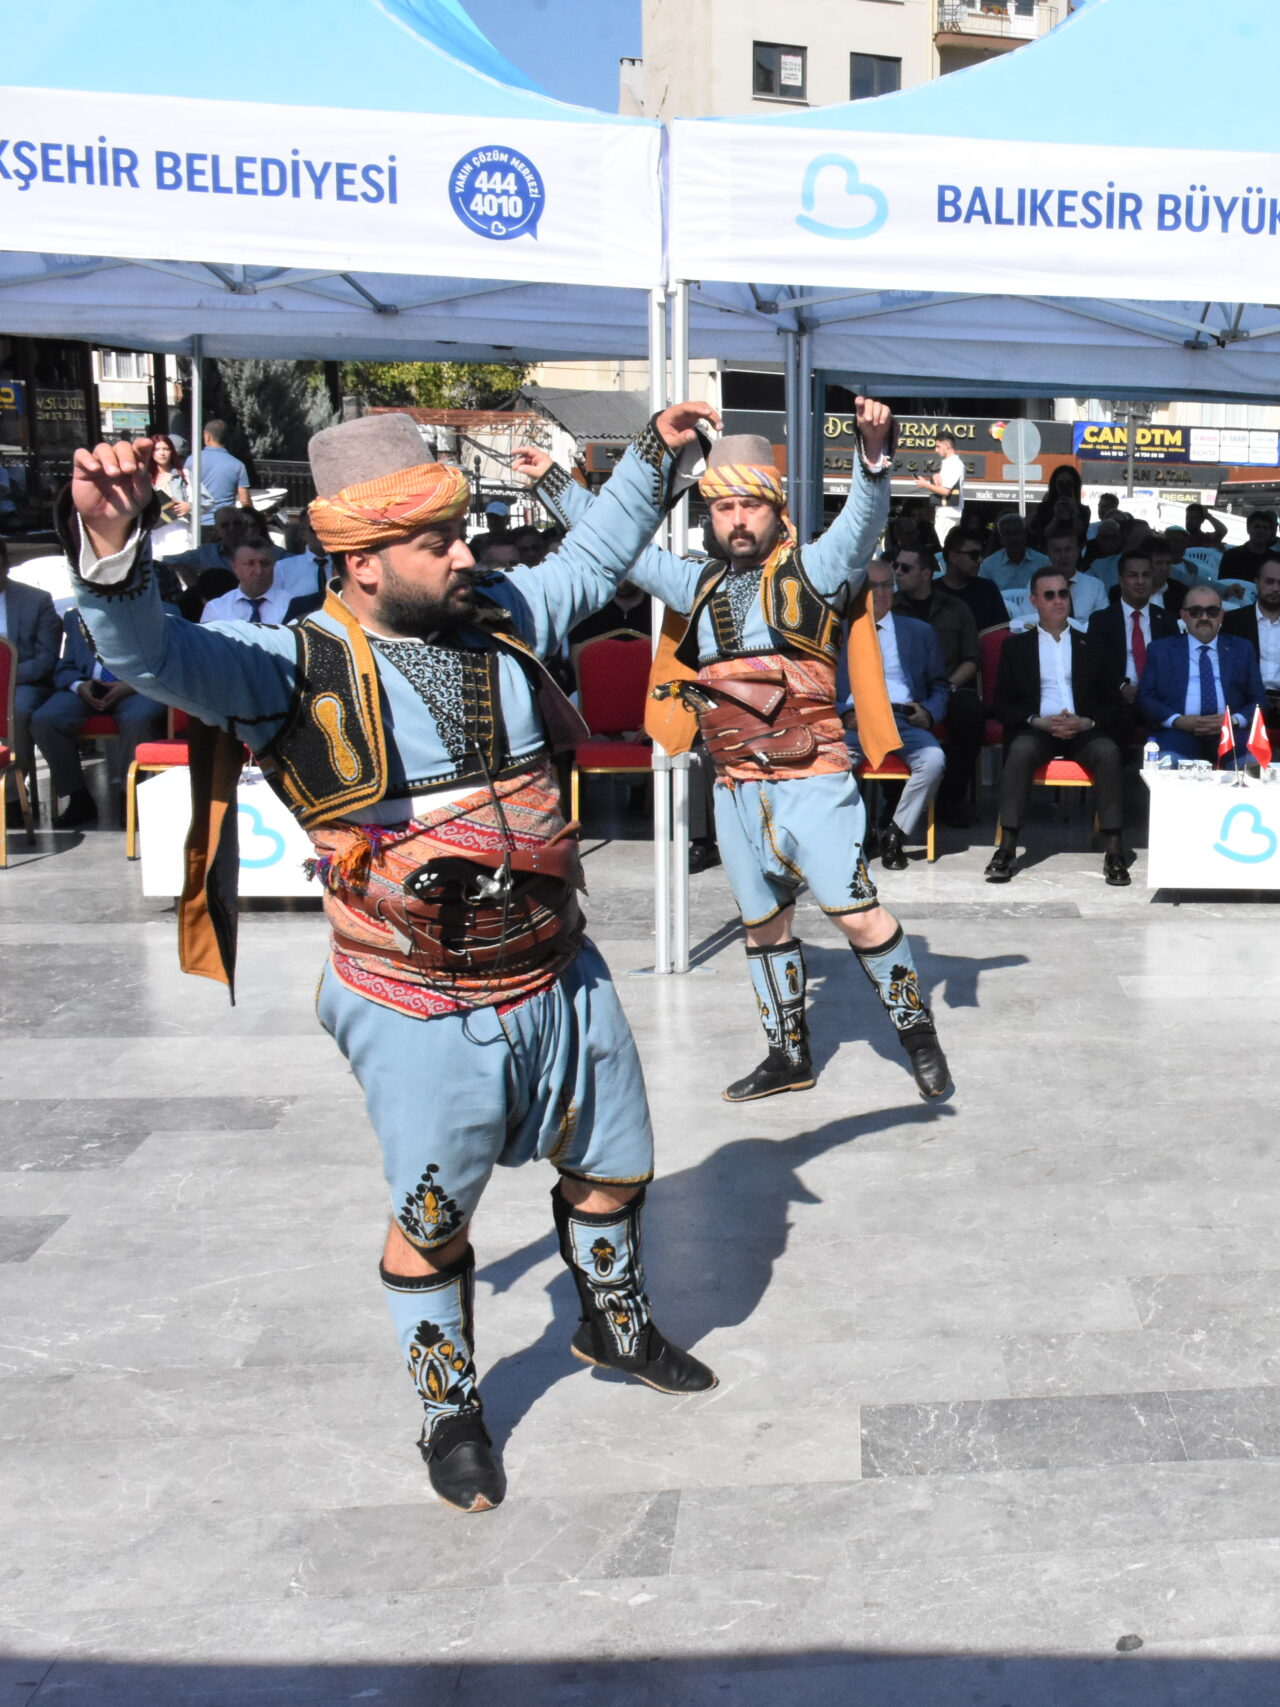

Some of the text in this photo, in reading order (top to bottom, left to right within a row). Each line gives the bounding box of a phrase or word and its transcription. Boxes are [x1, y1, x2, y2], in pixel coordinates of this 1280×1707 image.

[155, 149, 398, 204] BELEDİYESİ
[455, 150, 541, 198] YAKIN ÇÖZÜM MERKEZİ
[474, 170, 517, 195] 444
[470, 193, 523, 218] 4010
[937, 181, 1143, 230] BALIKESİR
[1084, 426, 1182, 447] CAN DTM
[1162, 492, 1199, 503] REGAL
